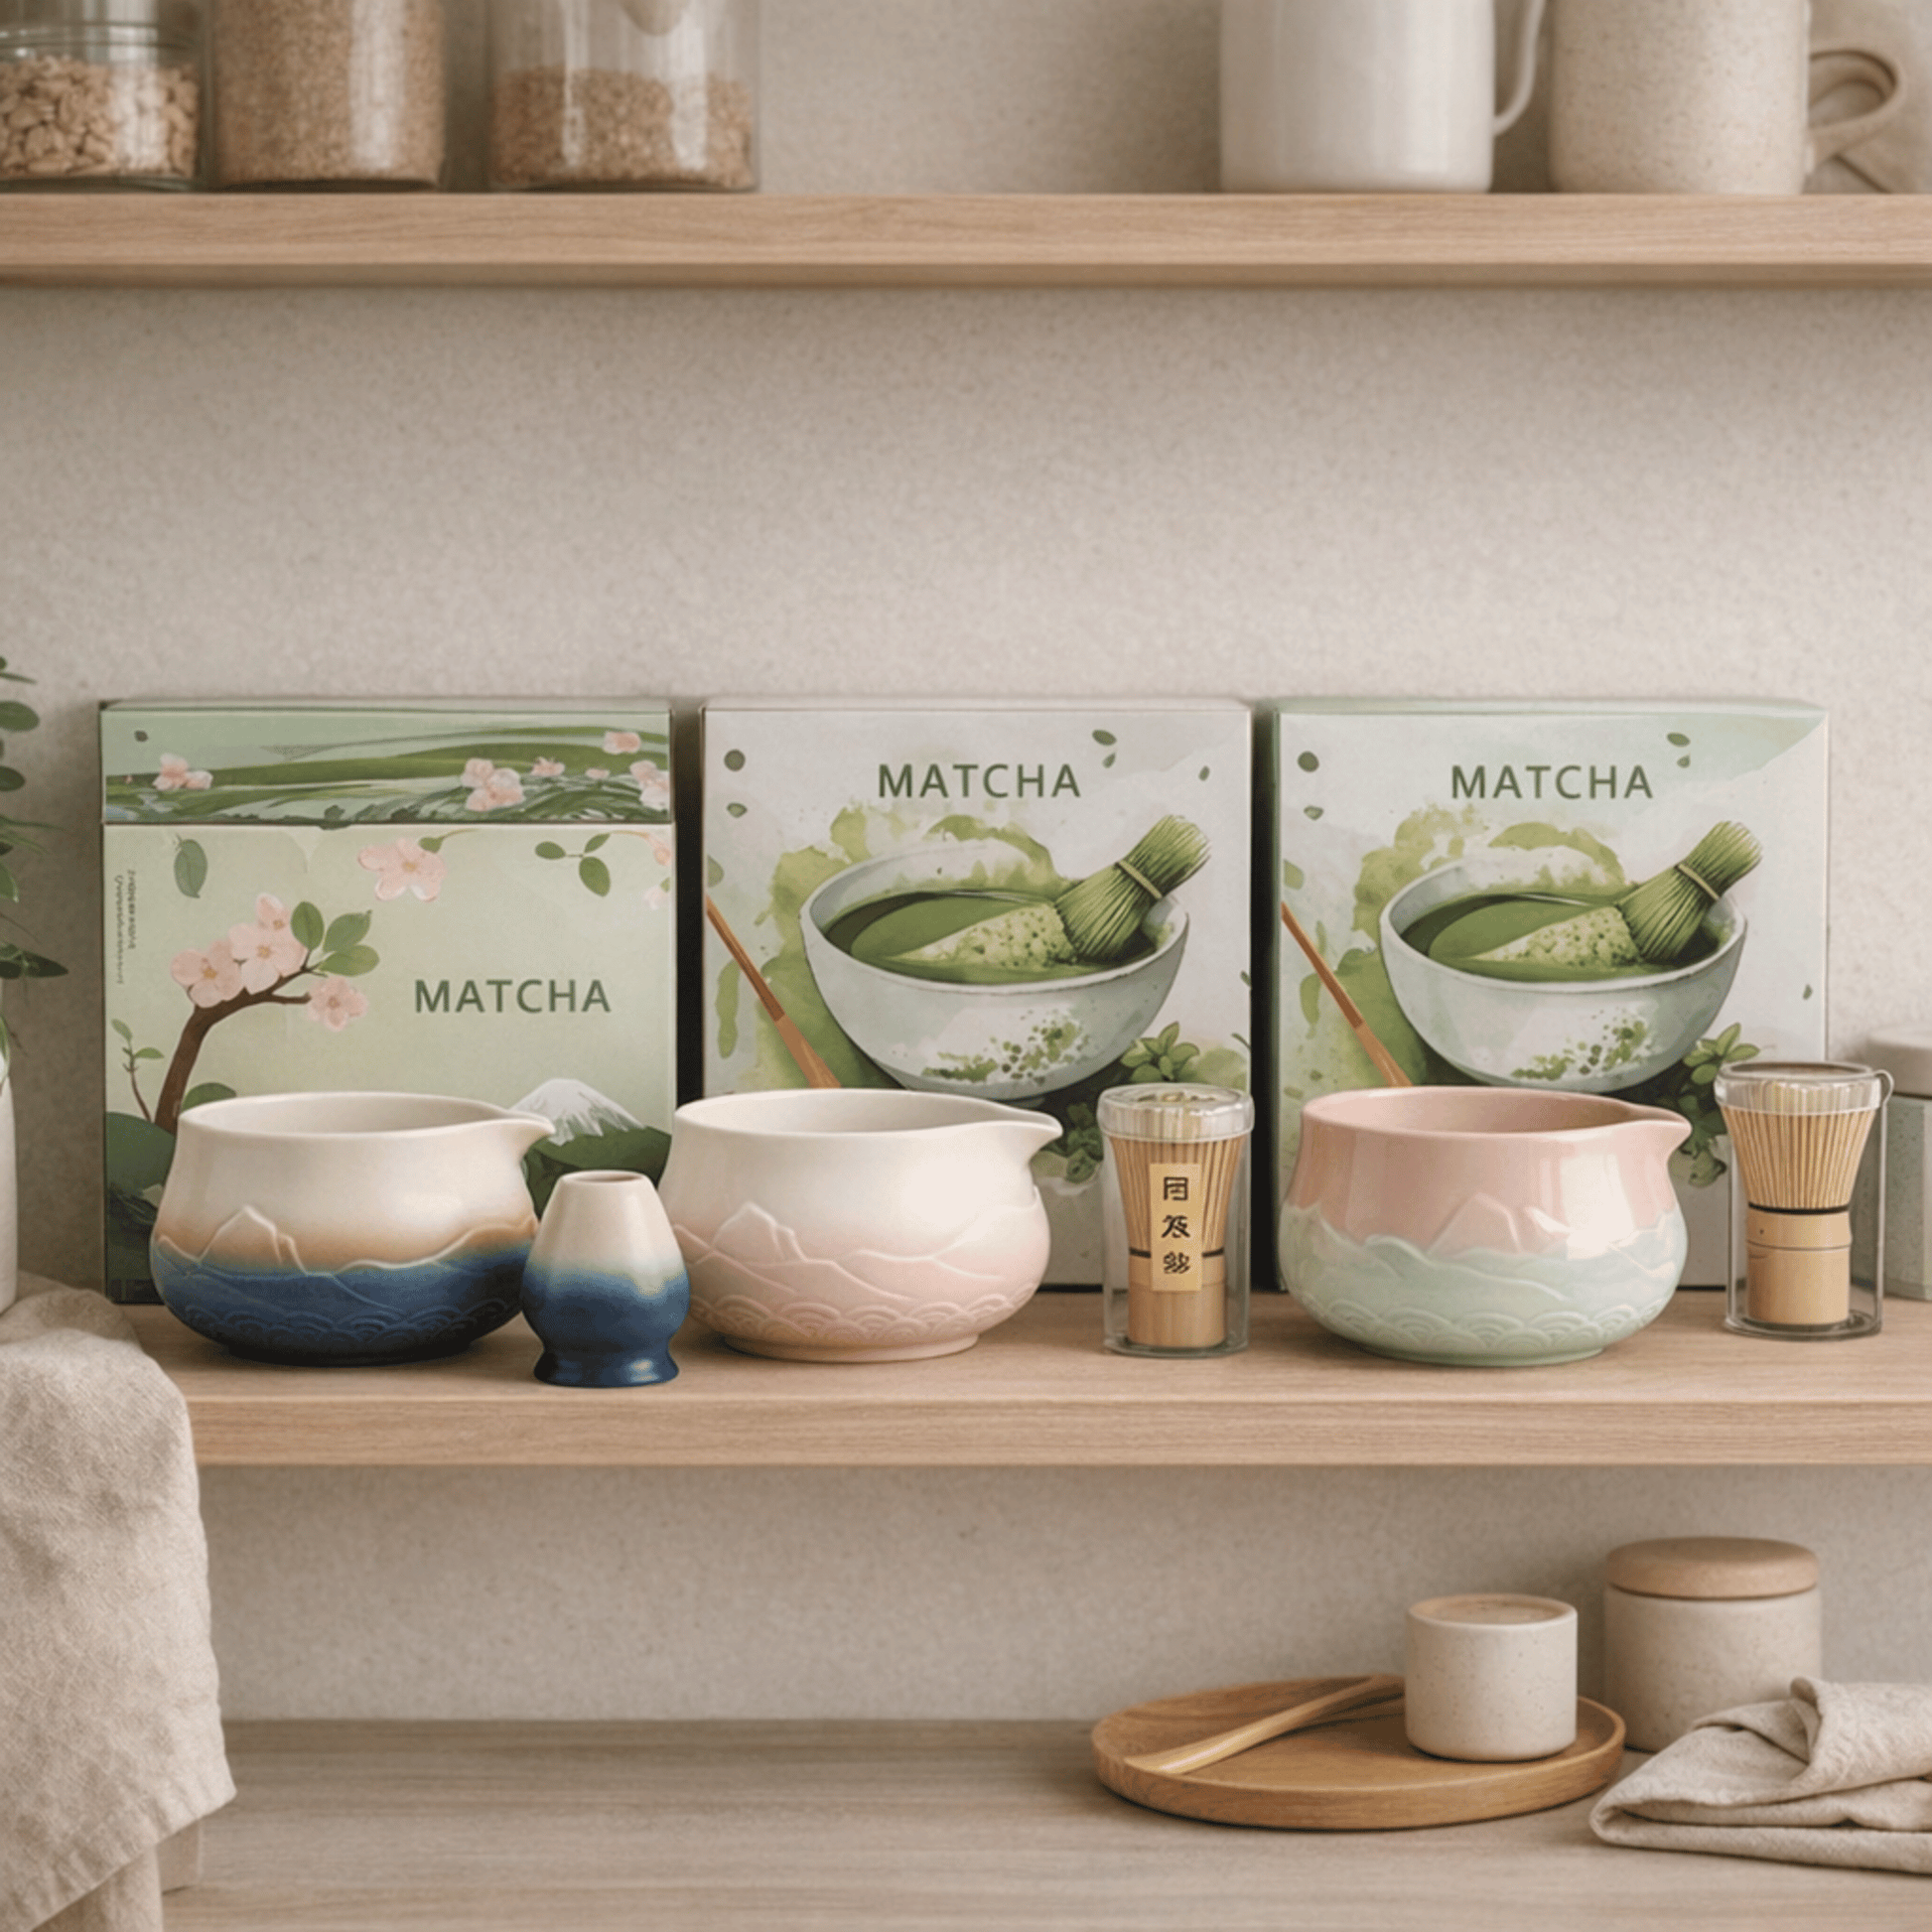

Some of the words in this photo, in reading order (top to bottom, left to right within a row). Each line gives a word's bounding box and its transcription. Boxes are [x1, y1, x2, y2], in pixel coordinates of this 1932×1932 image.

[879, 763, 1081, 798] MATCHA
[1450, 764, 1653, 799] MATCHA
[415, 979, 612, 1014] MATCHA
